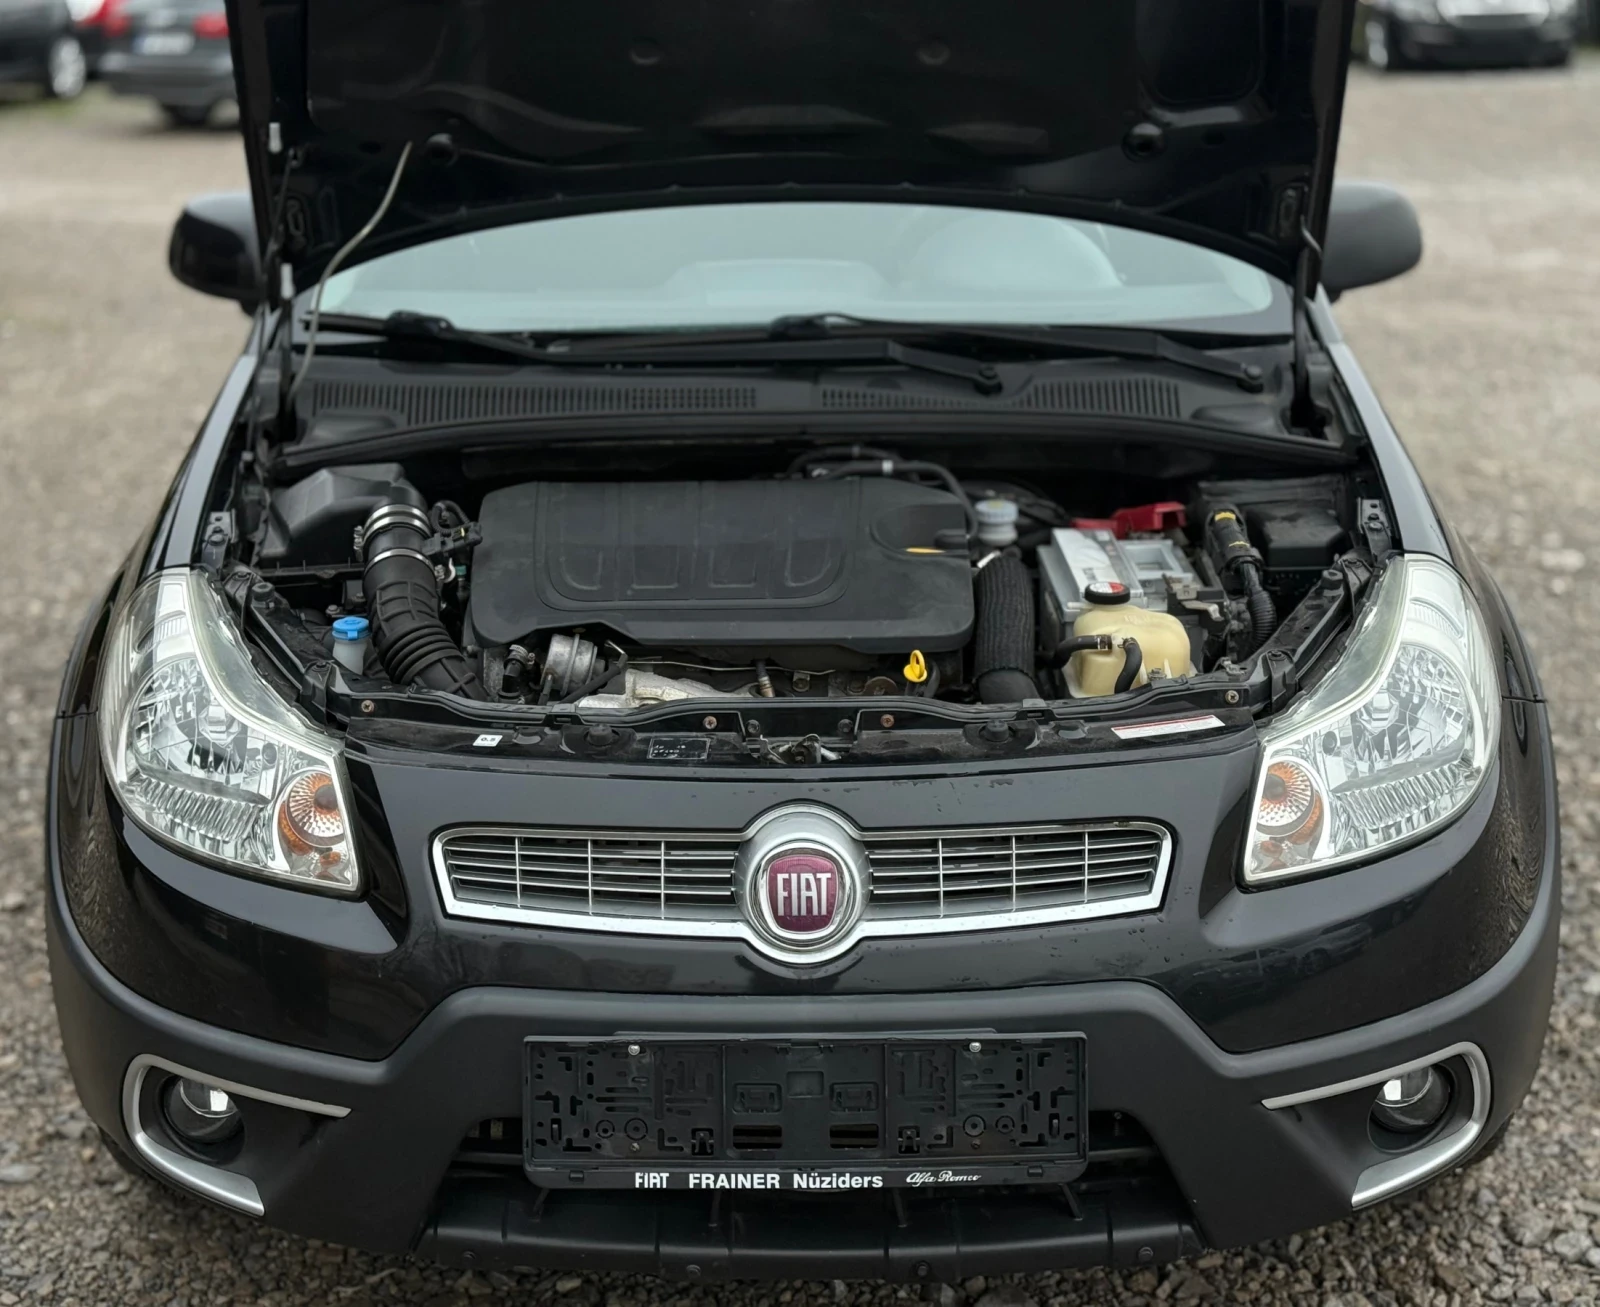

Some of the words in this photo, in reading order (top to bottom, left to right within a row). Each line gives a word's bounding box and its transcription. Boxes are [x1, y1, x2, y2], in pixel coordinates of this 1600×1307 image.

[777, 873, 832, 917] FIAT
[635, 1172, 670, 1189] FIAT
[689, 1173, 780, 1189] FRAINER
[793, 1172, 884, 1189] Nüziders
[905, 1172, 937, 1188] Alfa
